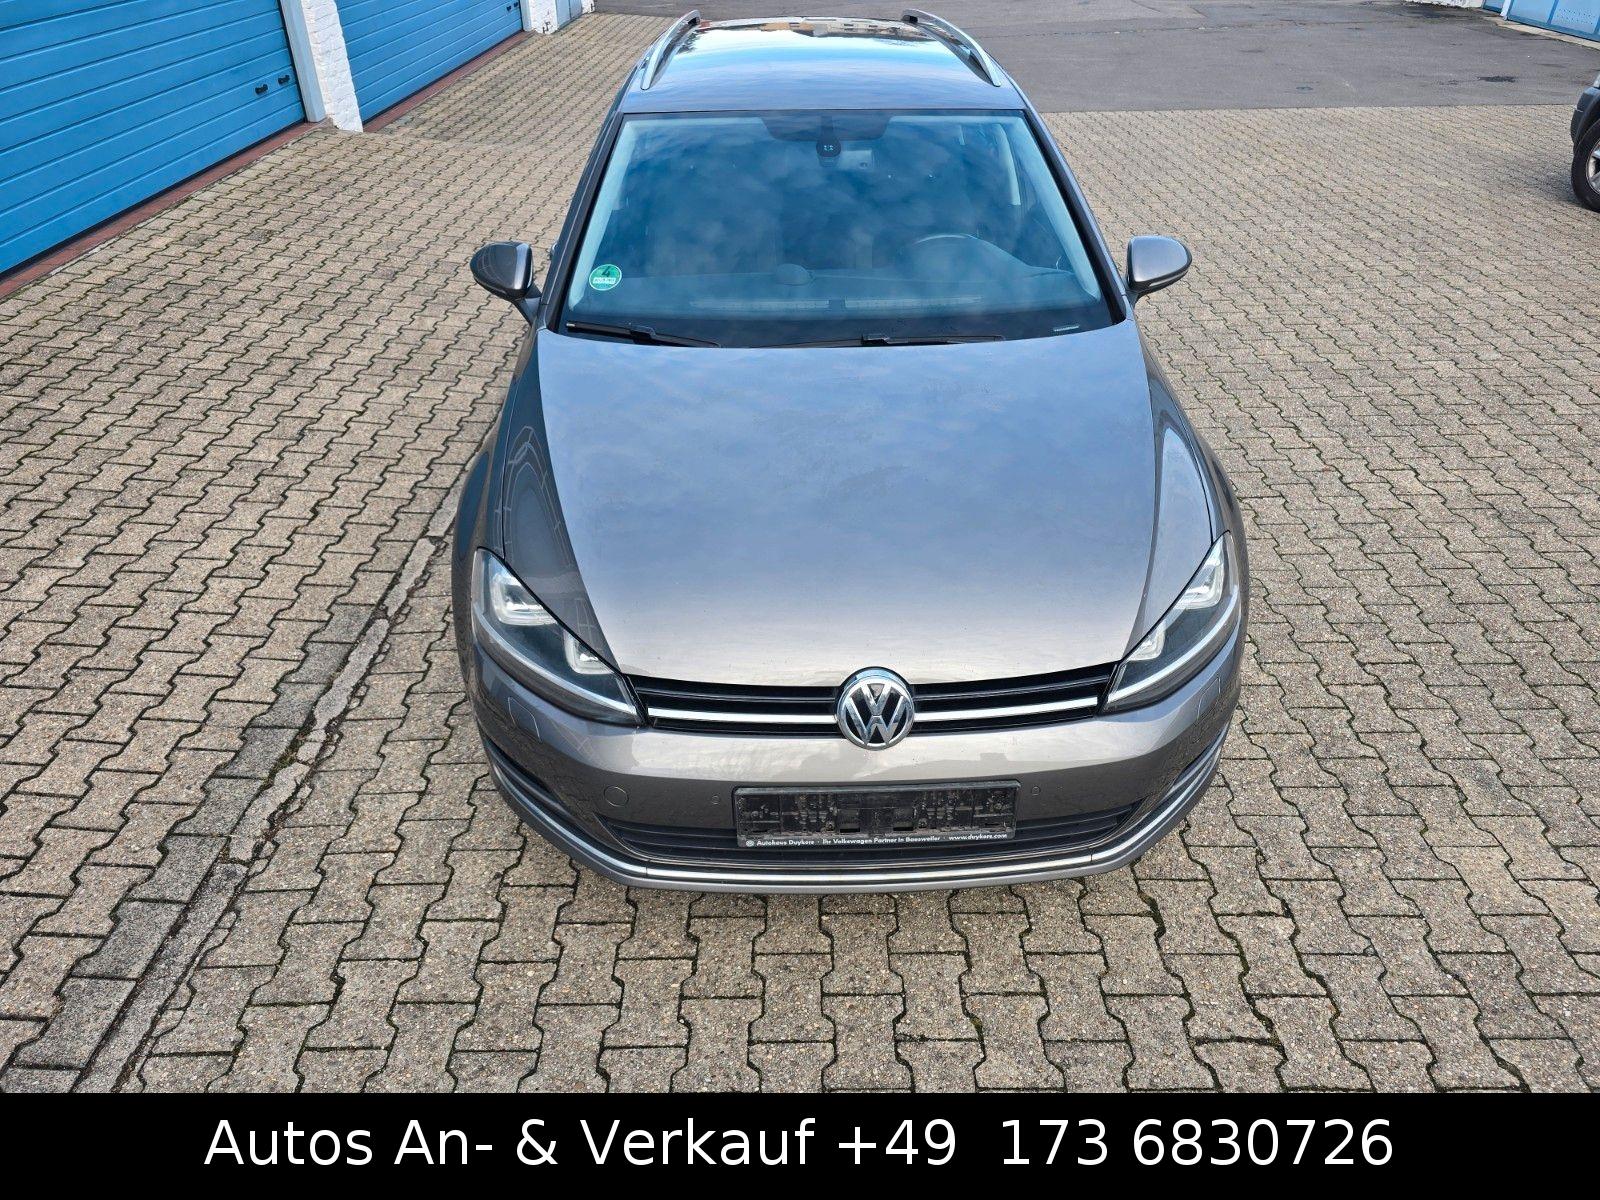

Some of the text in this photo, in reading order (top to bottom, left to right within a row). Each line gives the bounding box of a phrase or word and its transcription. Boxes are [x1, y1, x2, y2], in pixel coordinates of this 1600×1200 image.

[601, 265, 611, 278] 4
[841, 676, 911, 748] VW
[756, 839, 787, 847] Autohaus
